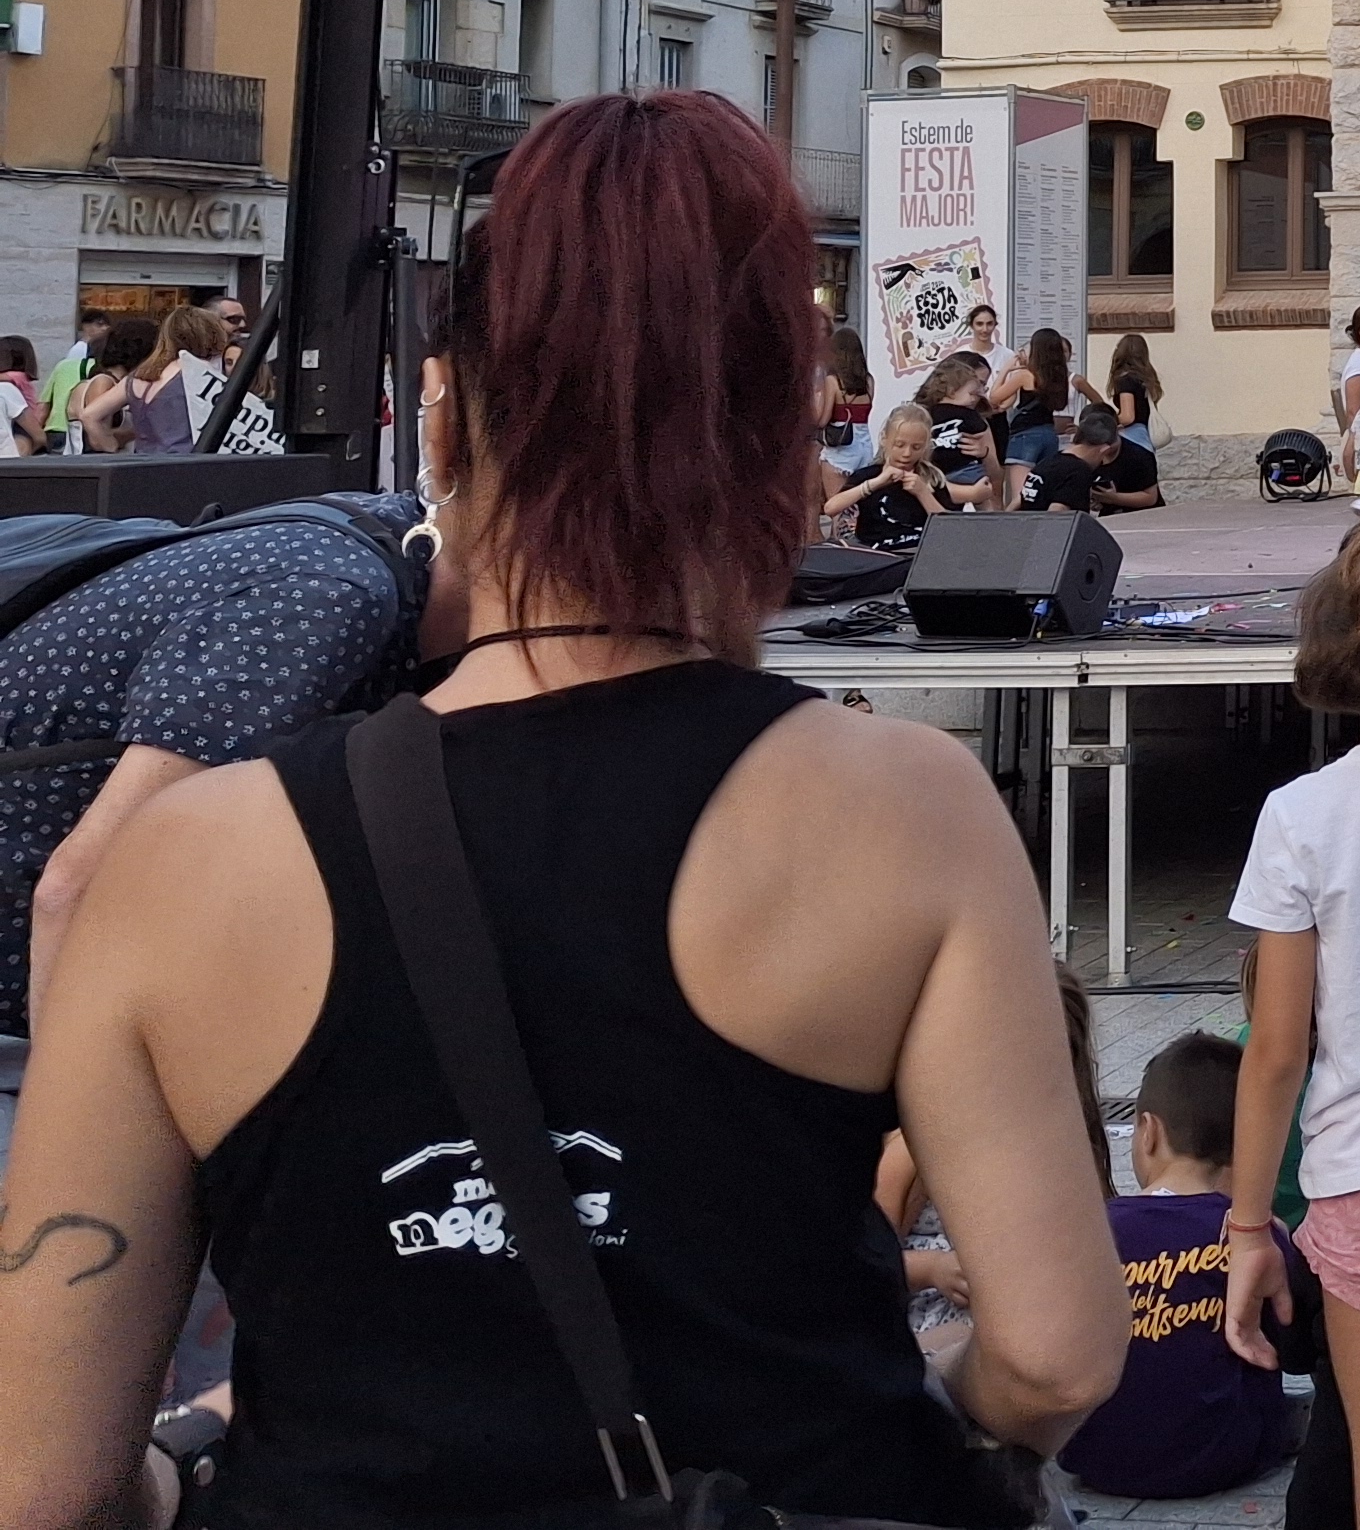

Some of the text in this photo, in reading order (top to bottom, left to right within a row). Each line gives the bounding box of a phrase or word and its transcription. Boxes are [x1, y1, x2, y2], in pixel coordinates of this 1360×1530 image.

[901, 117, 974, 146] Estem de
[899, 145, 975, 193] FESTA
[81, 193, 265, 241] FARMACIA
[899, 192, 976, 228] MAJOR!
[914, 285, 959, 312] FESTA
[916, 305, 960, 332] MAJOR
[388, 1191, 612, 1257] negs
[1121, 1243, 1232, 1290] ournes
[1130, 1293, 1225, 1343] ntseny
